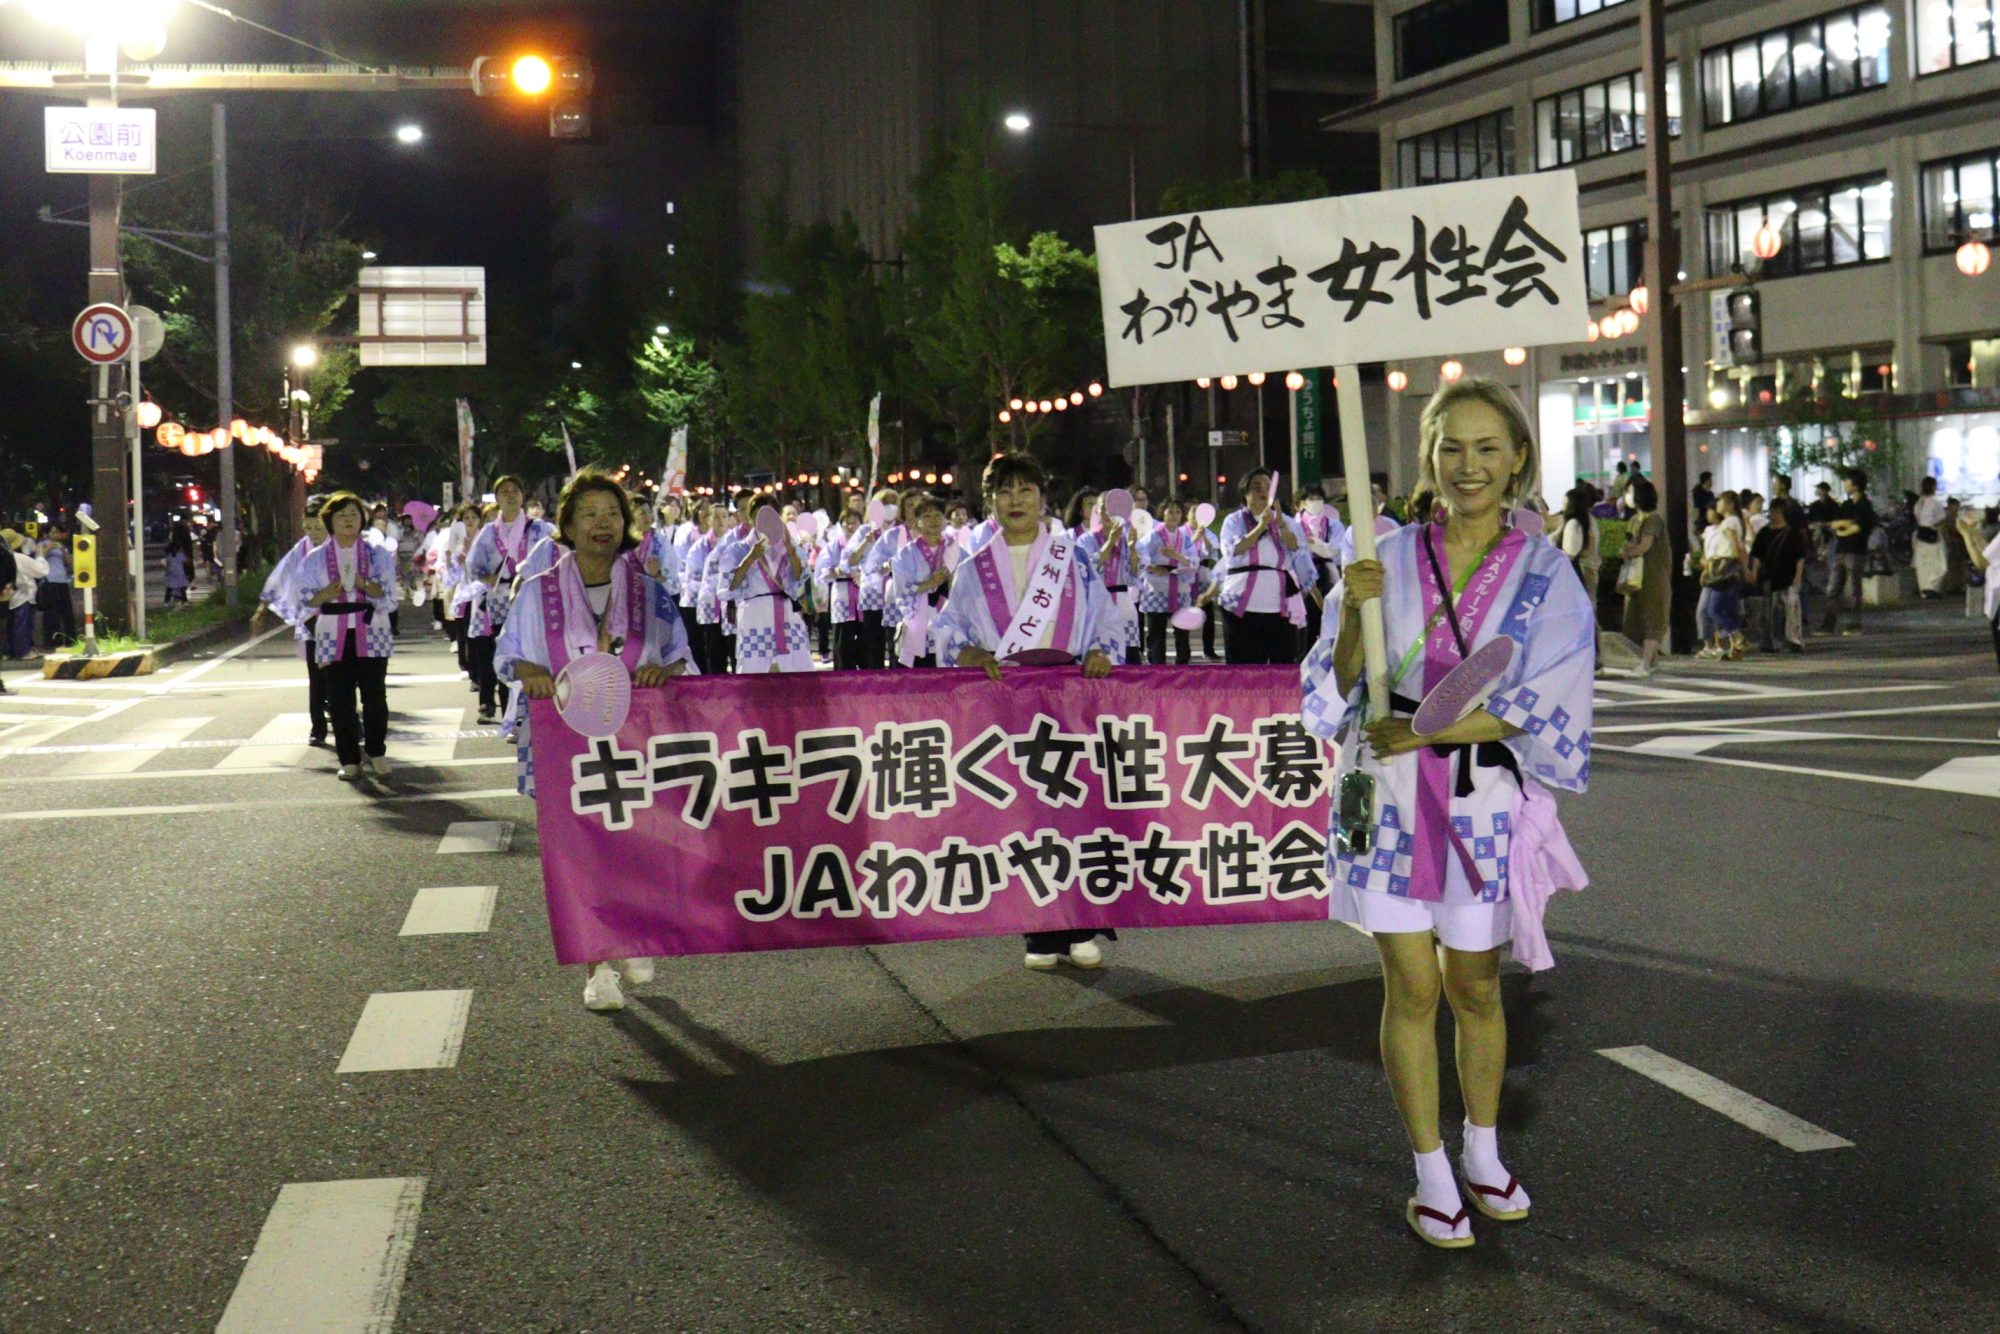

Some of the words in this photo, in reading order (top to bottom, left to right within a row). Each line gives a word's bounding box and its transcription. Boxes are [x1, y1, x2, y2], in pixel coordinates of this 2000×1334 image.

[60, 122, 141, 146] 公園前
[64, 148, 138, 162] Koenmae
[1121, 195, 1568, 345] わかやま女性会
[1146, 215, 1224, 273] JA
[1303, 379, 1315, 459] ゆうちょ銀行
[572, 712, 1340, 831] キラキラ輝く女性大募
[735, 821, 1331, 922] JAわかやま女性会
